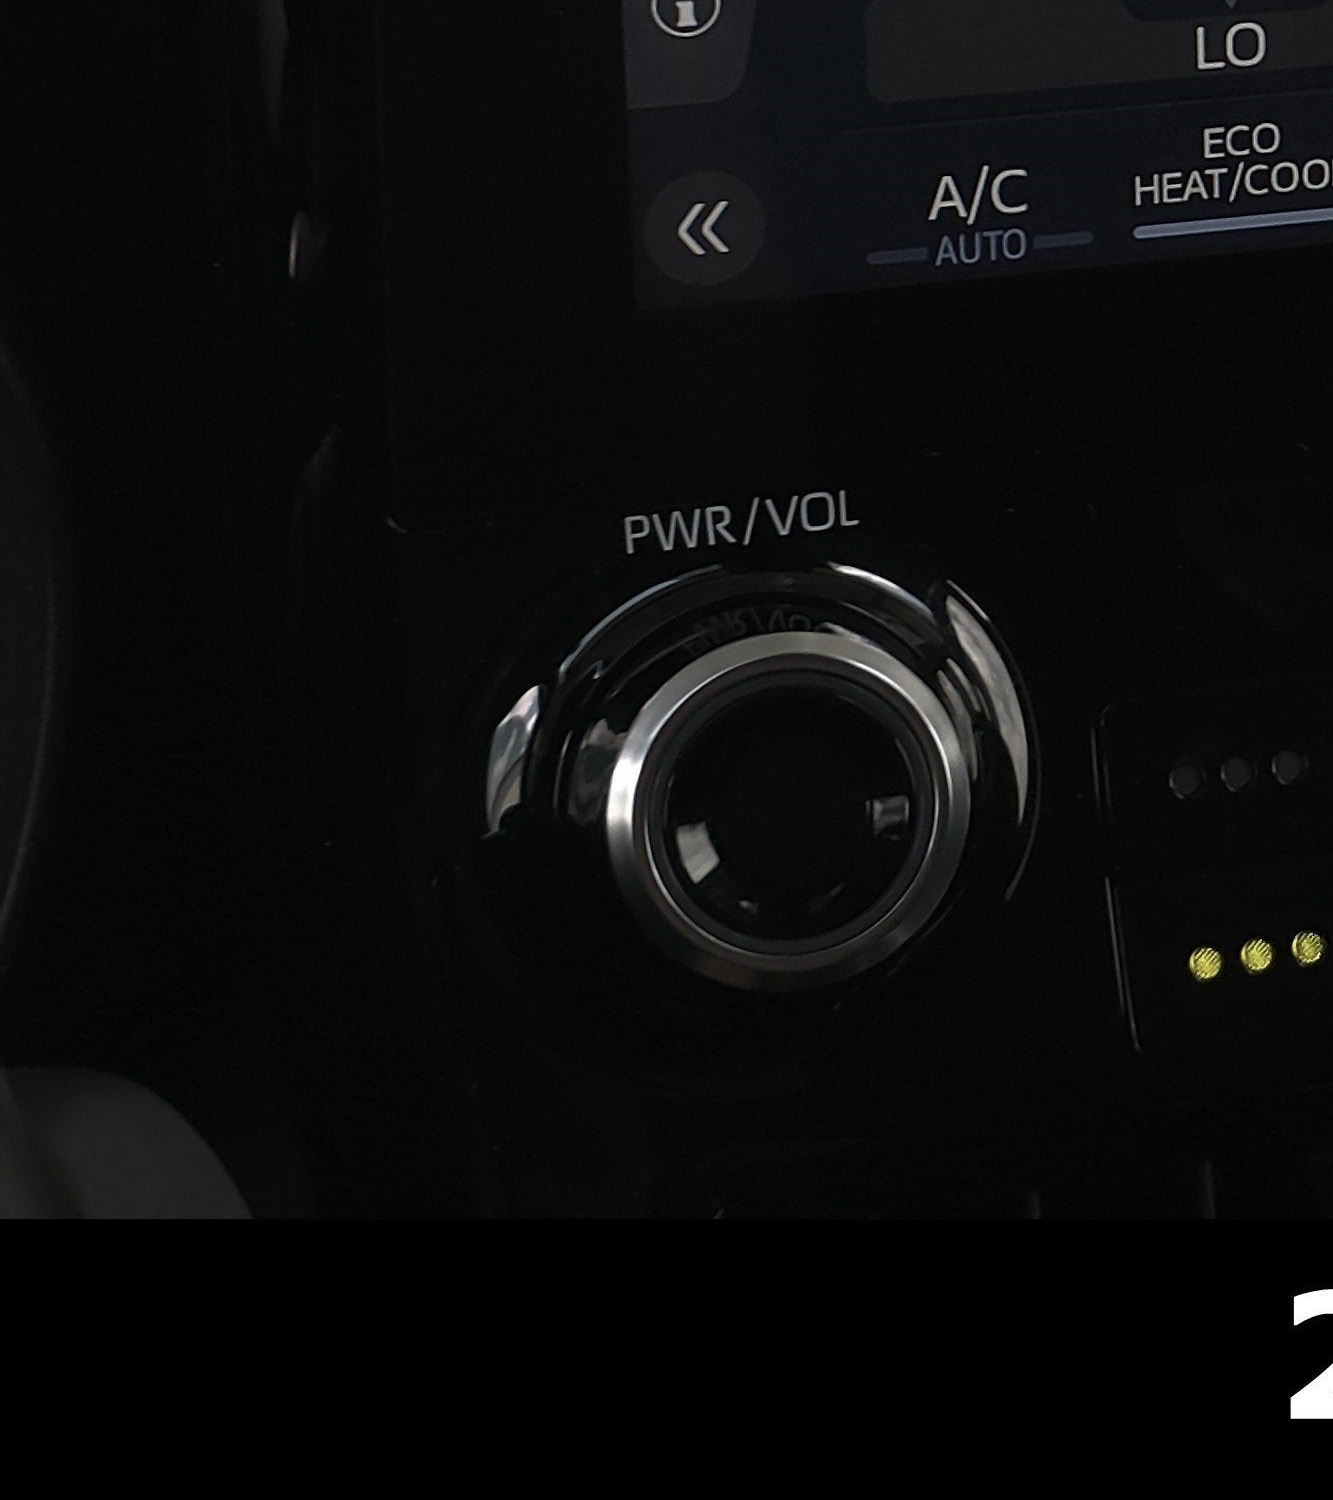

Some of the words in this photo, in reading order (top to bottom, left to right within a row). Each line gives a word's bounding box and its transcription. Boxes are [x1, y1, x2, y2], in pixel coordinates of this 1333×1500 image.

[1195, 21, 1267, 71] LO
[1202, 122, 1281, 159] ECO
[927, 165, 1029, 224] A/C
[934, 228, 1028, 267] AUTO
[622, 490, 860, 554] PWR/VOL
